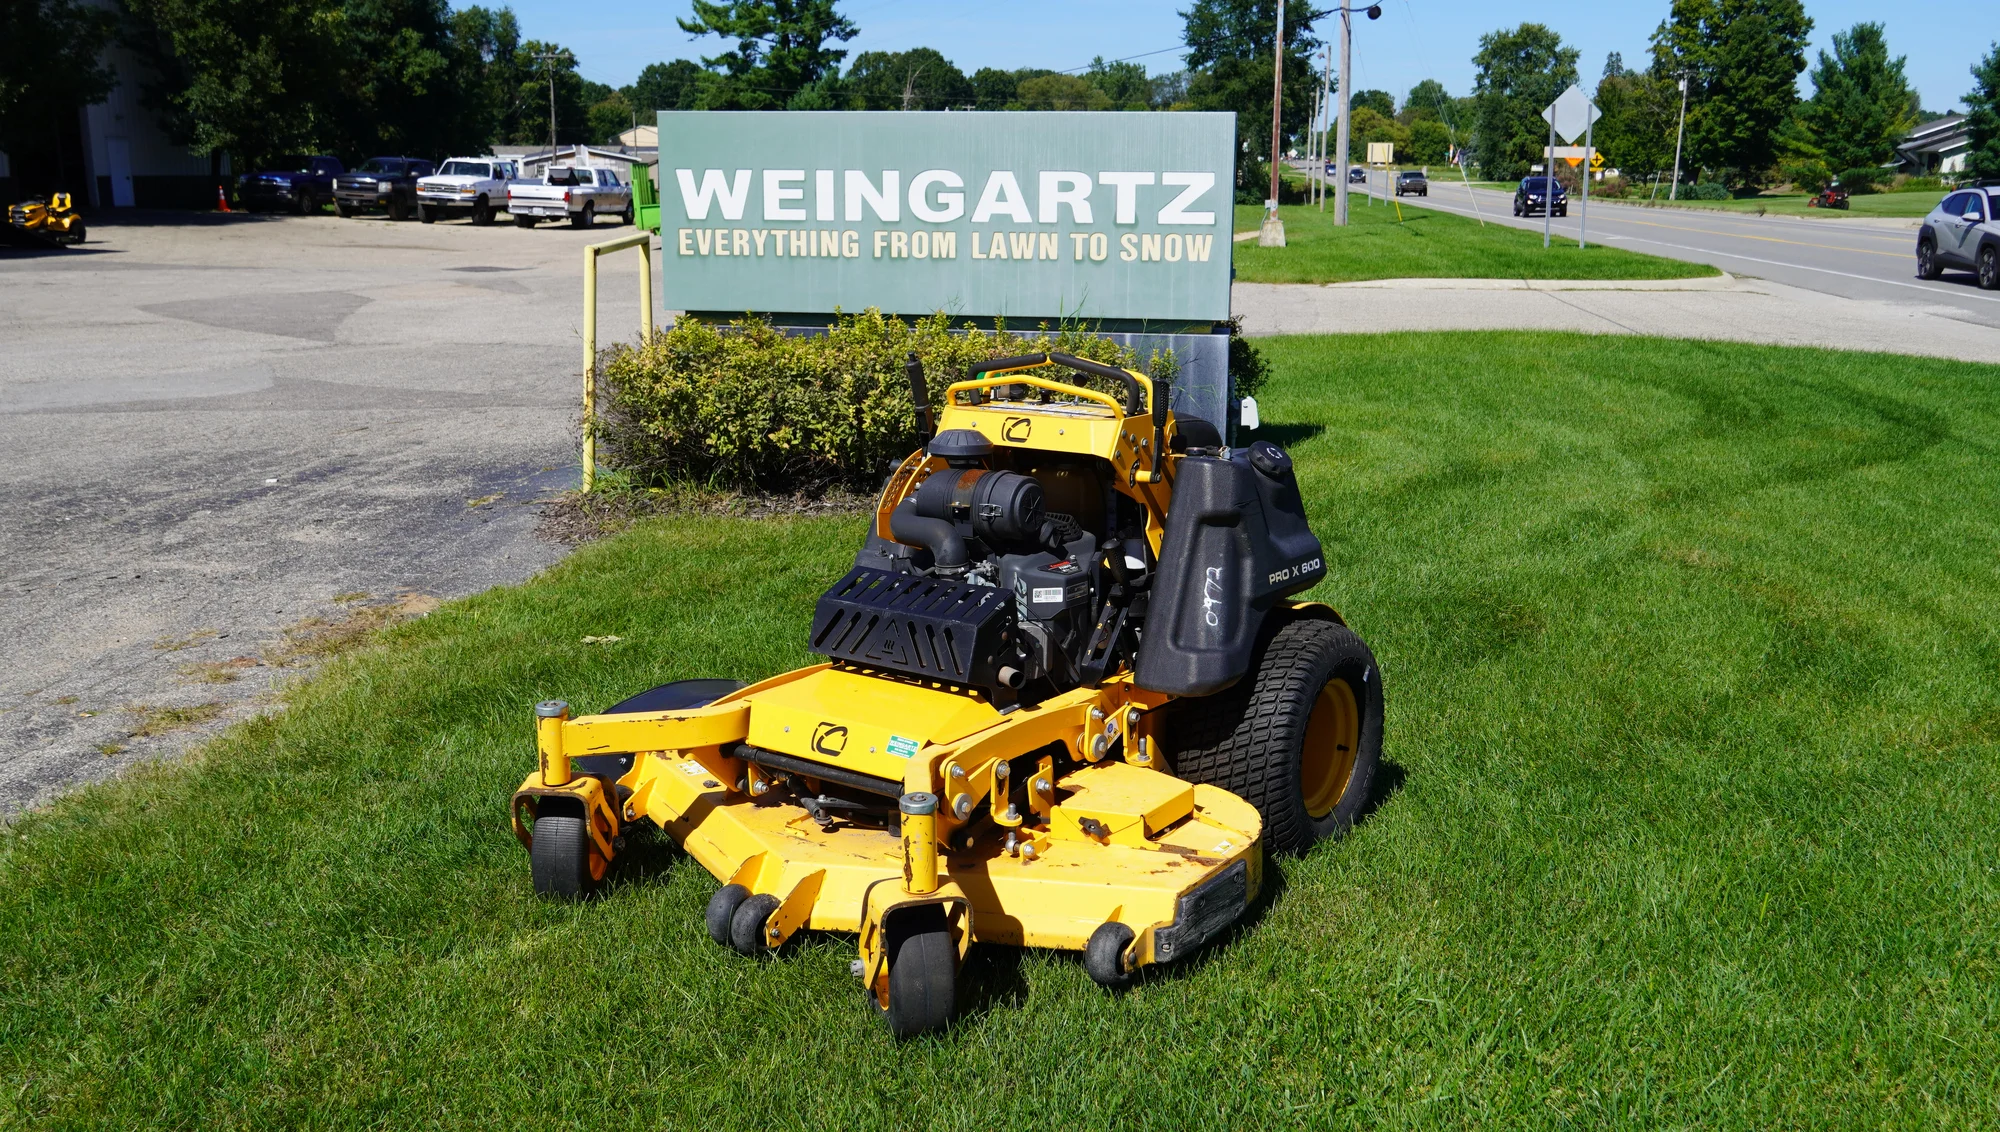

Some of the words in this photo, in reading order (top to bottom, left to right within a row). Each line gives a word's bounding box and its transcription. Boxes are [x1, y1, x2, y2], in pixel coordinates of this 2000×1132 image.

[675, 169, 1215, 225] WEINGARTZ
[678, 228, 860, 258] EVERYTHING
[873, 230, 957, 260] FROM
[971, 232, 1059, 261] LAWN
[1069, 233, 1108, 262] TO
[1119, 233, 1214, 263] SNOW
[1268, 568, 1290, 585] PRO
[1291, 565, 1300, 578] X
[1301, 558, 1321, 574] 600
